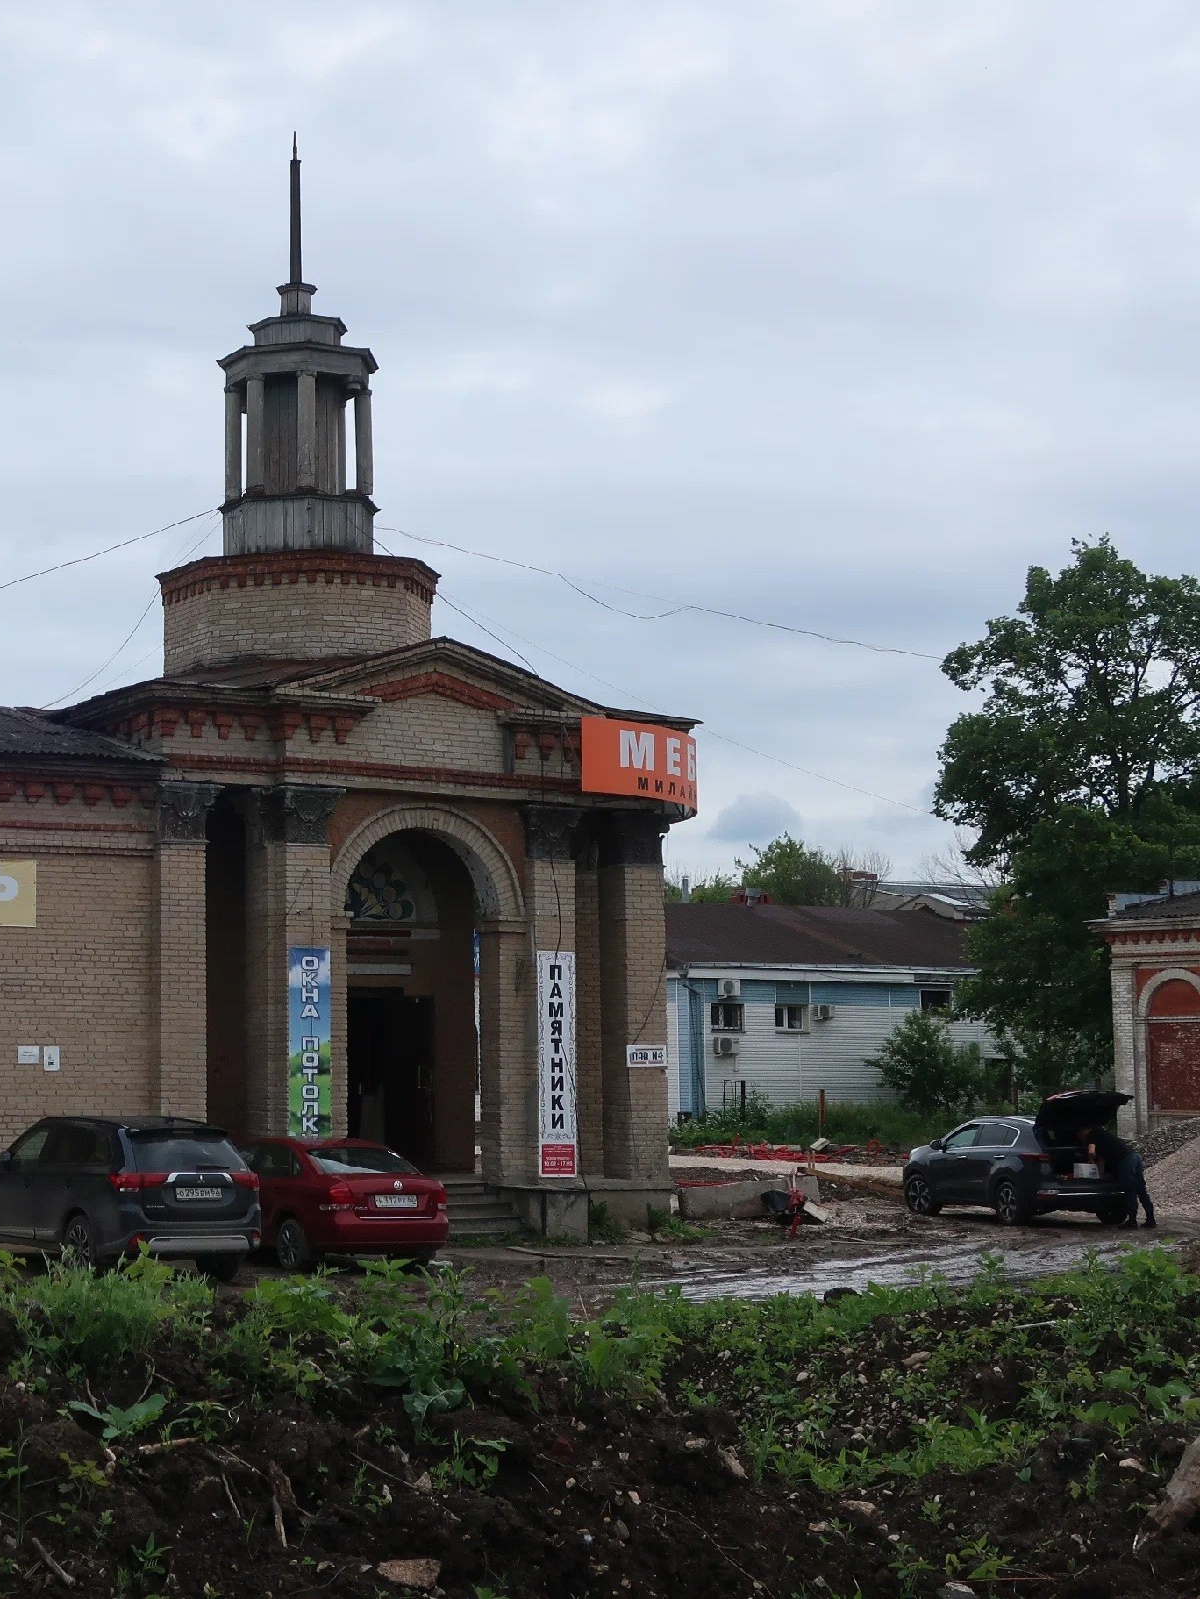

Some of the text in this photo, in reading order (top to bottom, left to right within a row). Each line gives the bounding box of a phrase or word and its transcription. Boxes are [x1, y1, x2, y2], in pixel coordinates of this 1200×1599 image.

[301, 956, 320, 1137] ОКНА ПОТОЛК
[548, 964, 564, 1130] ПАМЯТНИКИ
